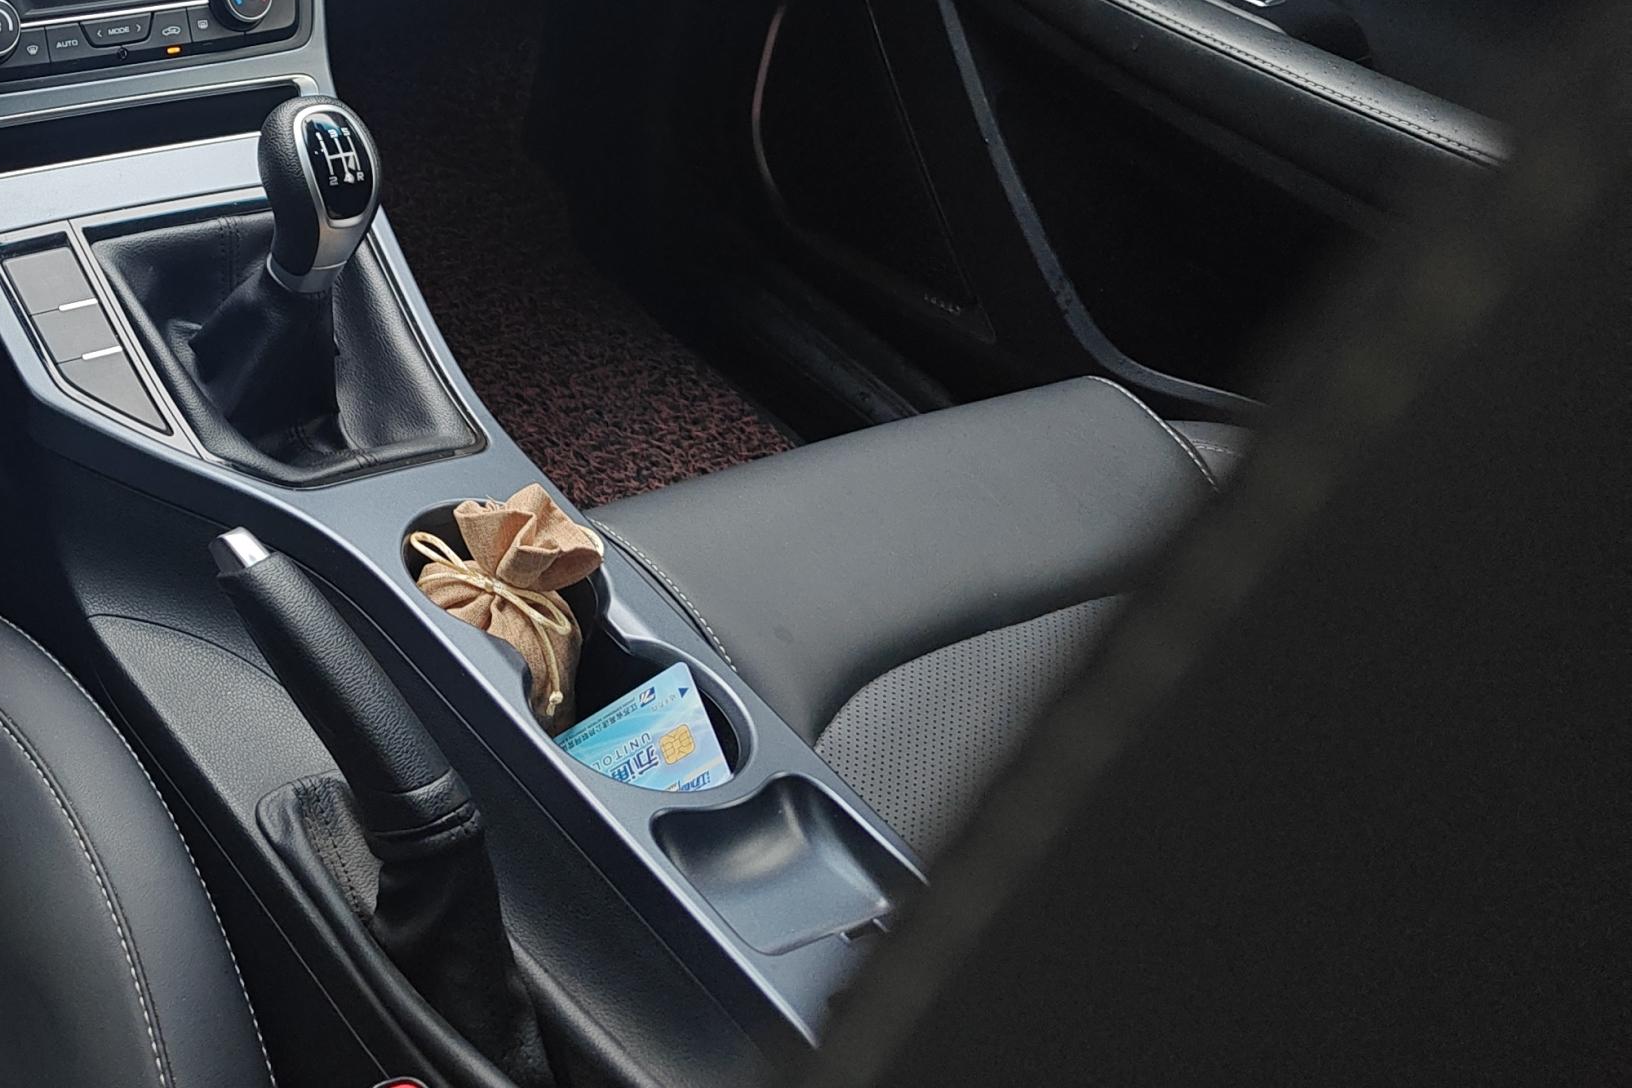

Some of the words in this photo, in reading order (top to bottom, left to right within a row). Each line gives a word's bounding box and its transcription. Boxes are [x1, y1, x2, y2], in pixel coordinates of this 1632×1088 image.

[108, 26, 130, 35] MODE
[56, 38, 79, 49] AUTO
[329, 176, 339, 186] 2
[356, 172, 365, 181] R
